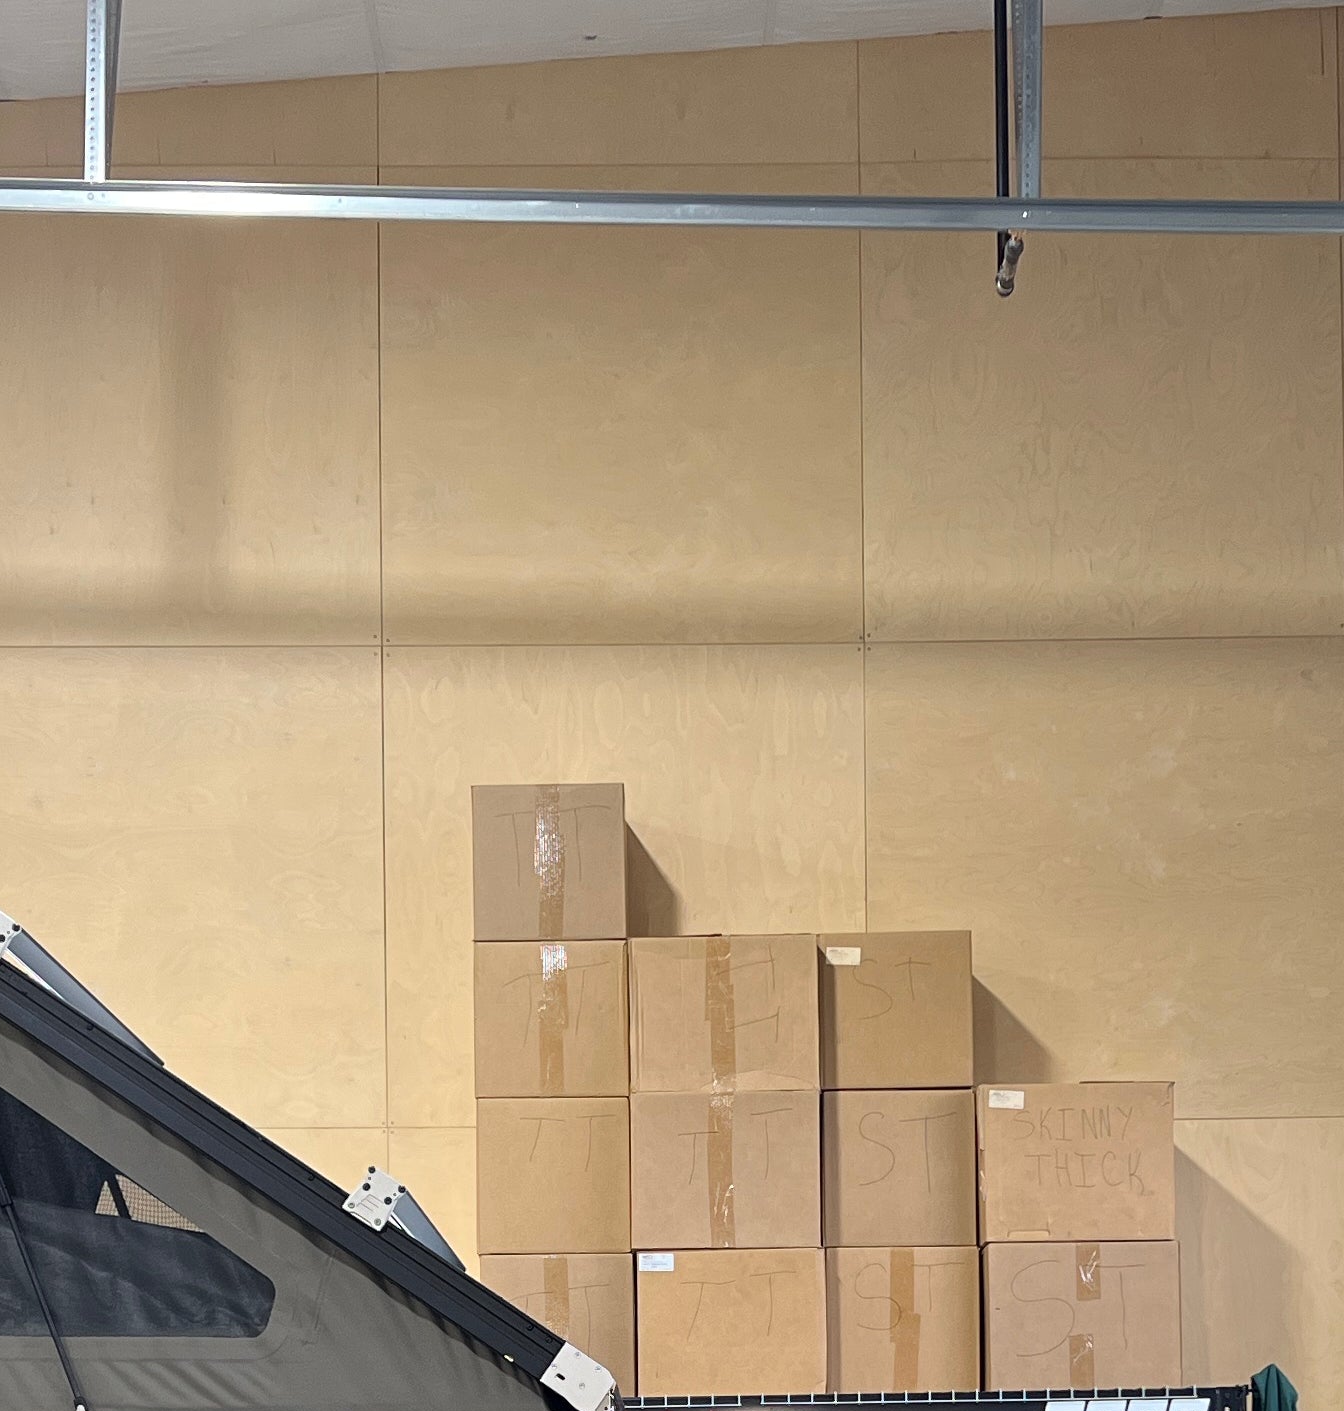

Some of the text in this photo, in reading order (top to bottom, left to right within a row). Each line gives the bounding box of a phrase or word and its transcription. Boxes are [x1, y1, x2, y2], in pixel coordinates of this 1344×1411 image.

[1012, 1105, 1134, 1142] SKINNY
[858, 1111, 957, 1194] ST
[1024, 1149, 1146, 1196] THICK
